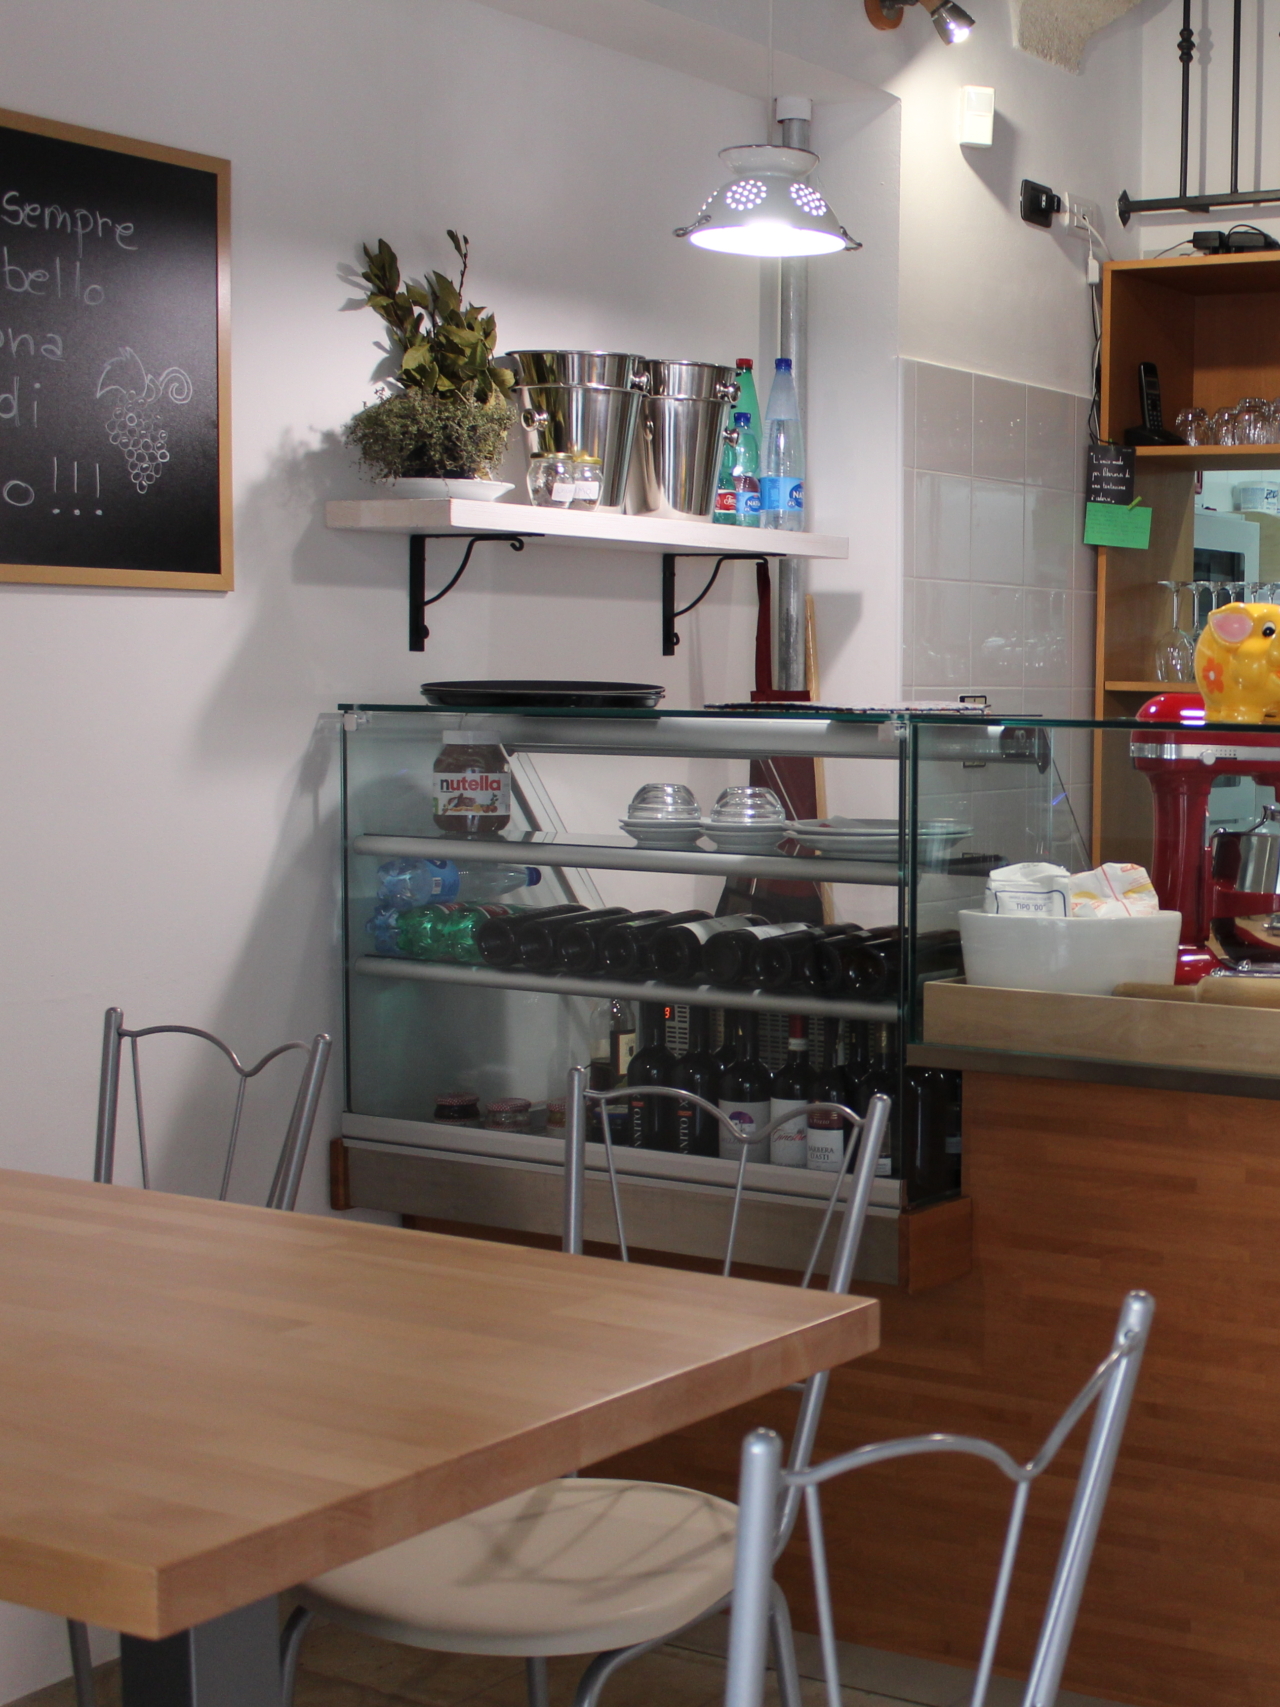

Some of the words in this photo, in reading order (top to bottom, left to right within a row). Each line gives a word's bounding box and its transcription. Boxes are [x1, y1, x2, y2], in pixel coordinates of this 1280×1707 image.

[1, 191, 138, 258] Sempre
[4, 246, 105, 305] bello
[0, 328, 66, 361] na
[0, 376, 41, 427] di
[440, 775, 502, 791] nutella
[1016, 903, 1030, 911] TIPO
